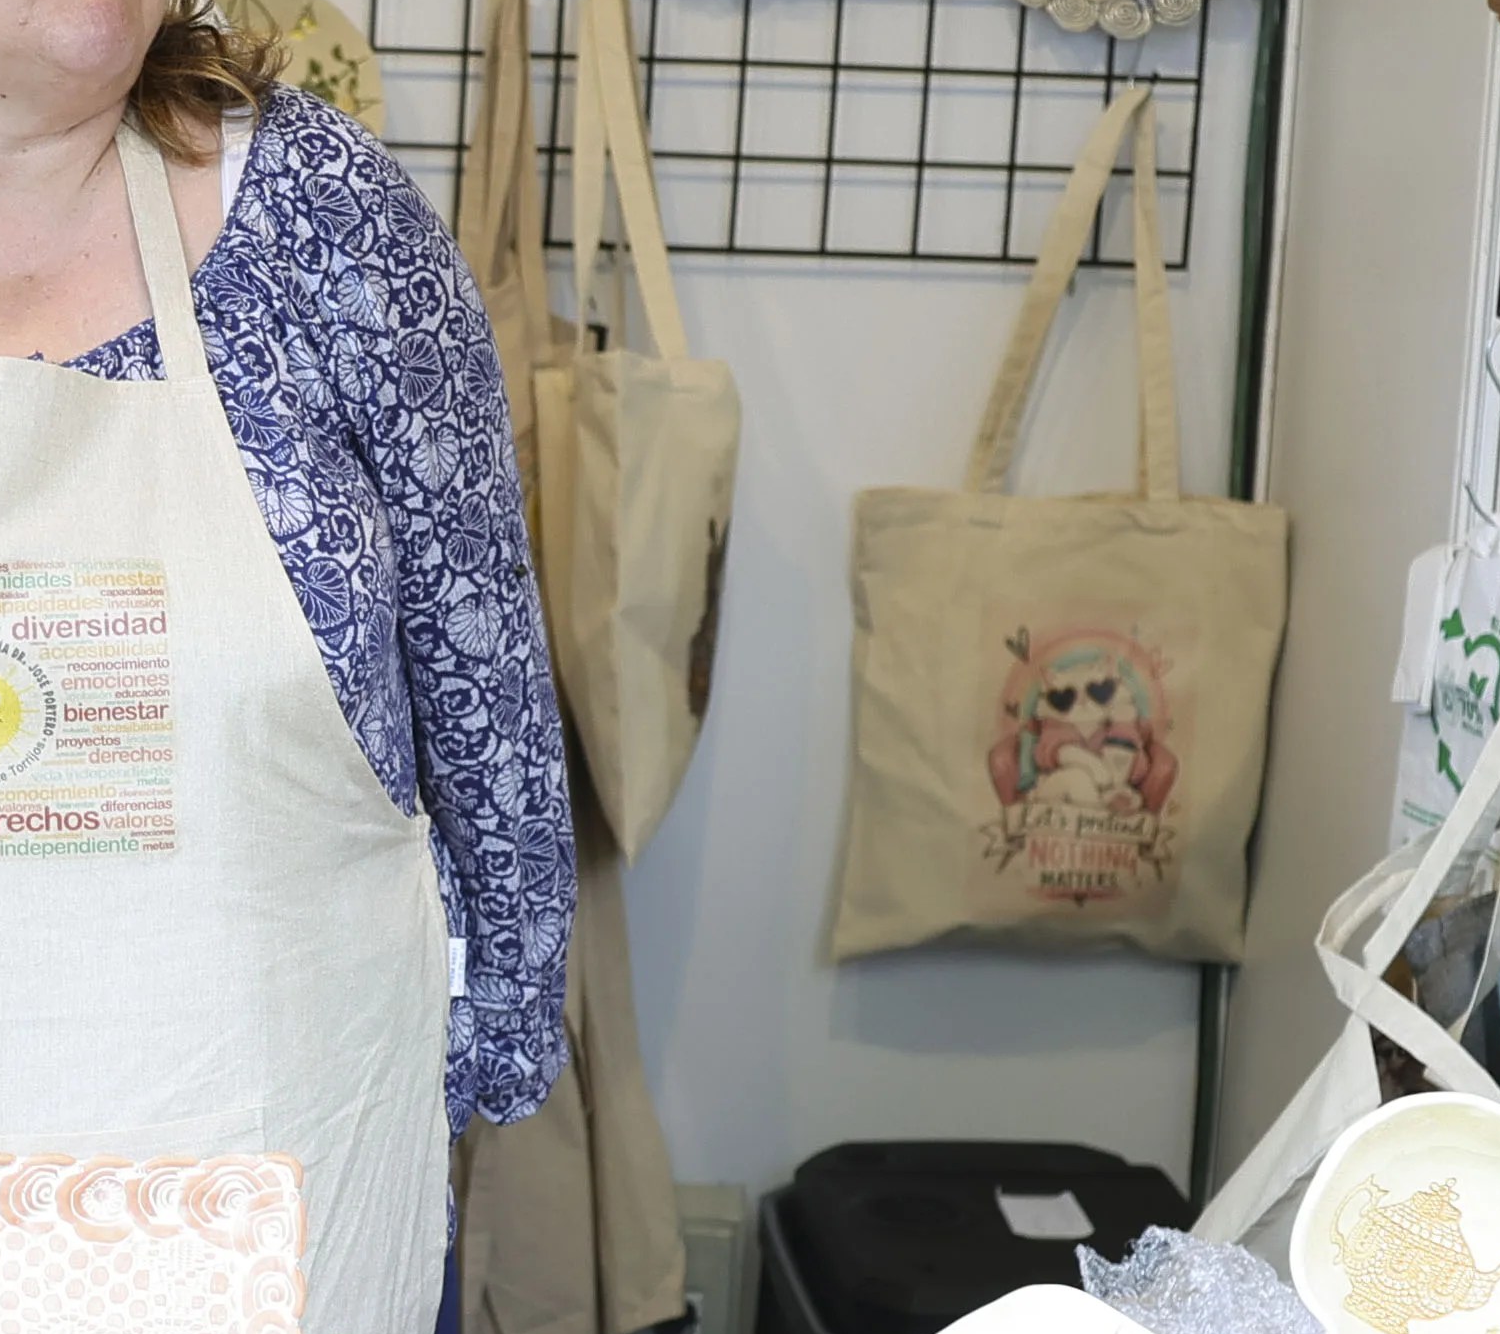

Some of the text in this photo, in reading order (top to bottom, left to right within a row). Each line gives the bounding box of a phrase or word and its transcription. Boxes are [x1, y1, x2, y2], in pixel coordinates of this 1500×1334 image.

[73, 570, 167, 588] bienestar
[100, 586, 165, 599] capacidades
[107, 596, 165, 610] inclusión
[11, 610, 168, 641] diversidad
[39, 639, 169, 662] accesibilidad
[65, 657, 170, 673] reconocimiento
[61, 671, 170, 690] emociones
[28, 663, 51, 690] JOSÉ
[42, 689, 58, 737] PORTERO
[115, 687, 170, 698] educación
[63, 700, 170, 723] bienestar
[55, 735, 122, 750] proyectos
[8, 741, 46, 777] Torrijos
[88, 746, 174, 765] derechos
[100, 798, 173, 813] diferencias
[103, 812, 175, 830] valores
[0, 836, 140, 860] independiente
[142, 840, 175, 853] metas
[1029, 836, 1138, 875] NOTHING
